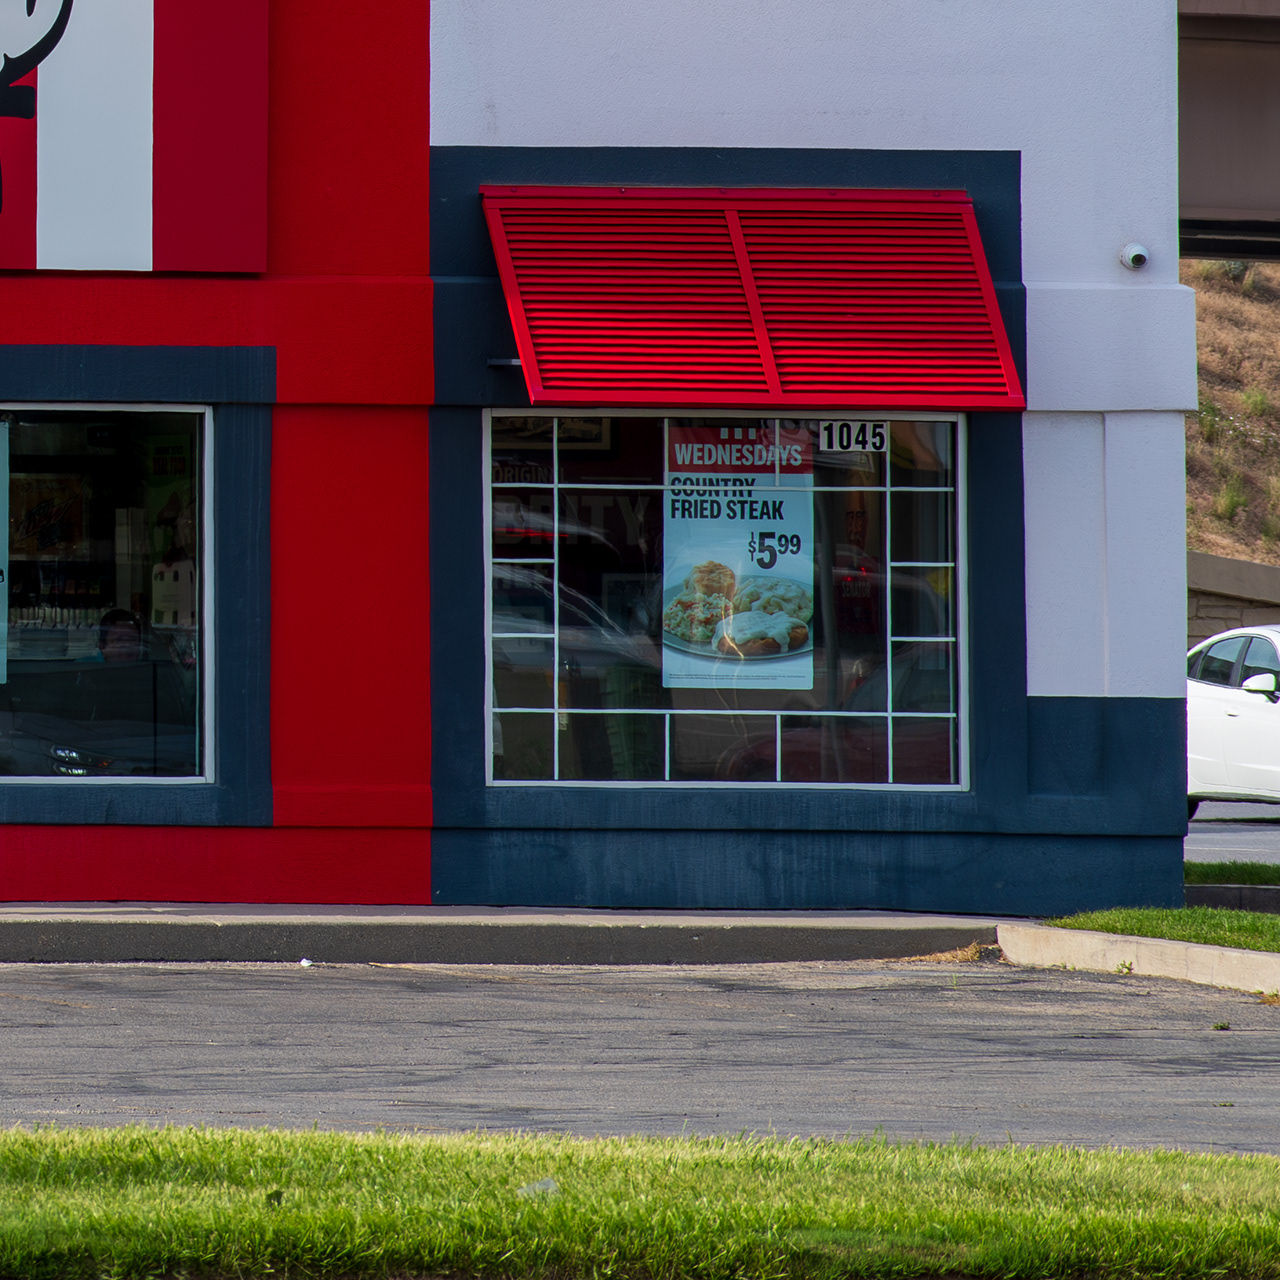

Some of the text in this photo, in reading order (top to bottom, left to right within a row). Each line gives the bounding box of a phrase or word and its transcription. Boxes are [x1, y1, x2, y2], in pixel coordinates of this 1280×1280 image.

[823, 423, 886, 451] 1045
[674, 443, 802, 467] WEDNESDAYS
[670, 476, 756, 499] COUNTRY
[670, 498, 784, 520] FRIED STEAK
